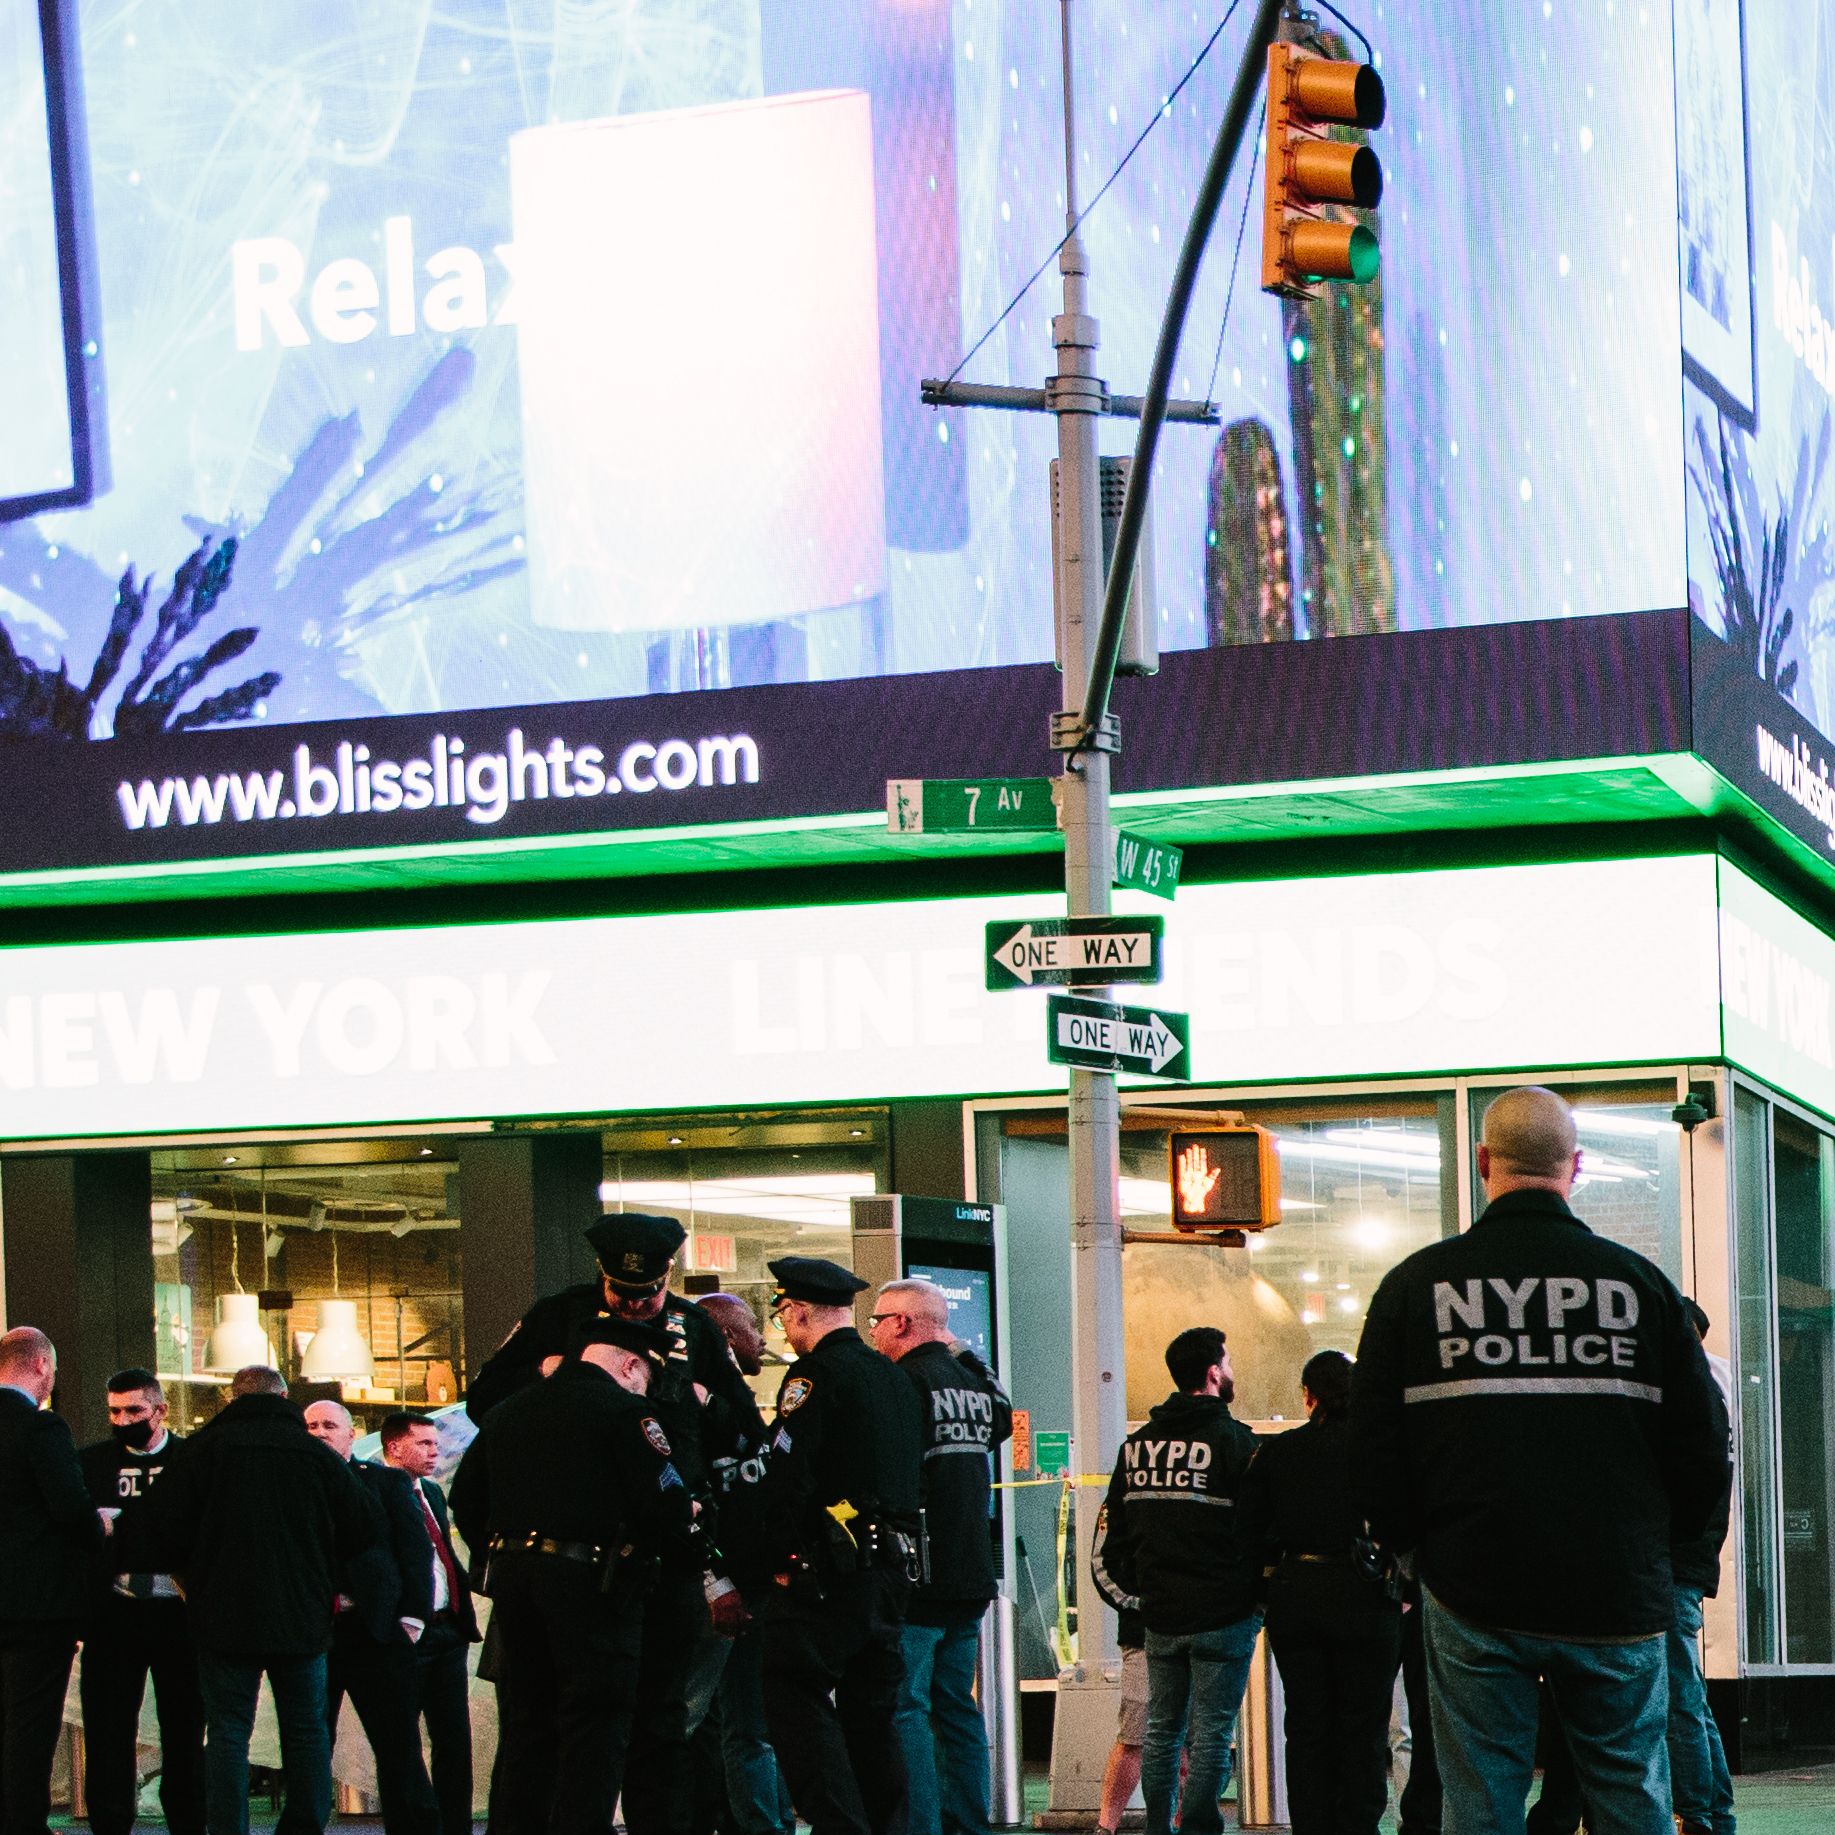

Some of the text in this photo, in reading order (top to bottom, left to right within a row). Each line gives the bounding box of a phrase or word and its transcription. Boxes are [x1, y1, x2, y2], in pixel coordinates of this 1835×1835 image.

[117, 728, 760, 825] www.blisslights.com
[964, 787, 981, 826] 7
[1120, 838, 1140, 880] W
[1142, 848, 1163, 888] 45
[1011, 937, 1139, 968] ONE WAY
[243, 971, 559, 1082] YORK
[728, 945, 984, 1056] LINE
[1069, 1018, 1171, 1058] ONE WAY
[955, 1206, 991, 1223] LinkNYC
[695, 1235, 732, 1269] EXIT
[1433, 1276, 1641, 1333] NYPD
[1438, 1334, 1639, 1370] POLICE
[932, 1388, 992, 1423] NYPD
[1124, 1439, 1212, 1471] NYPD
[1125, 1470, 1209, 1490] POLICE
